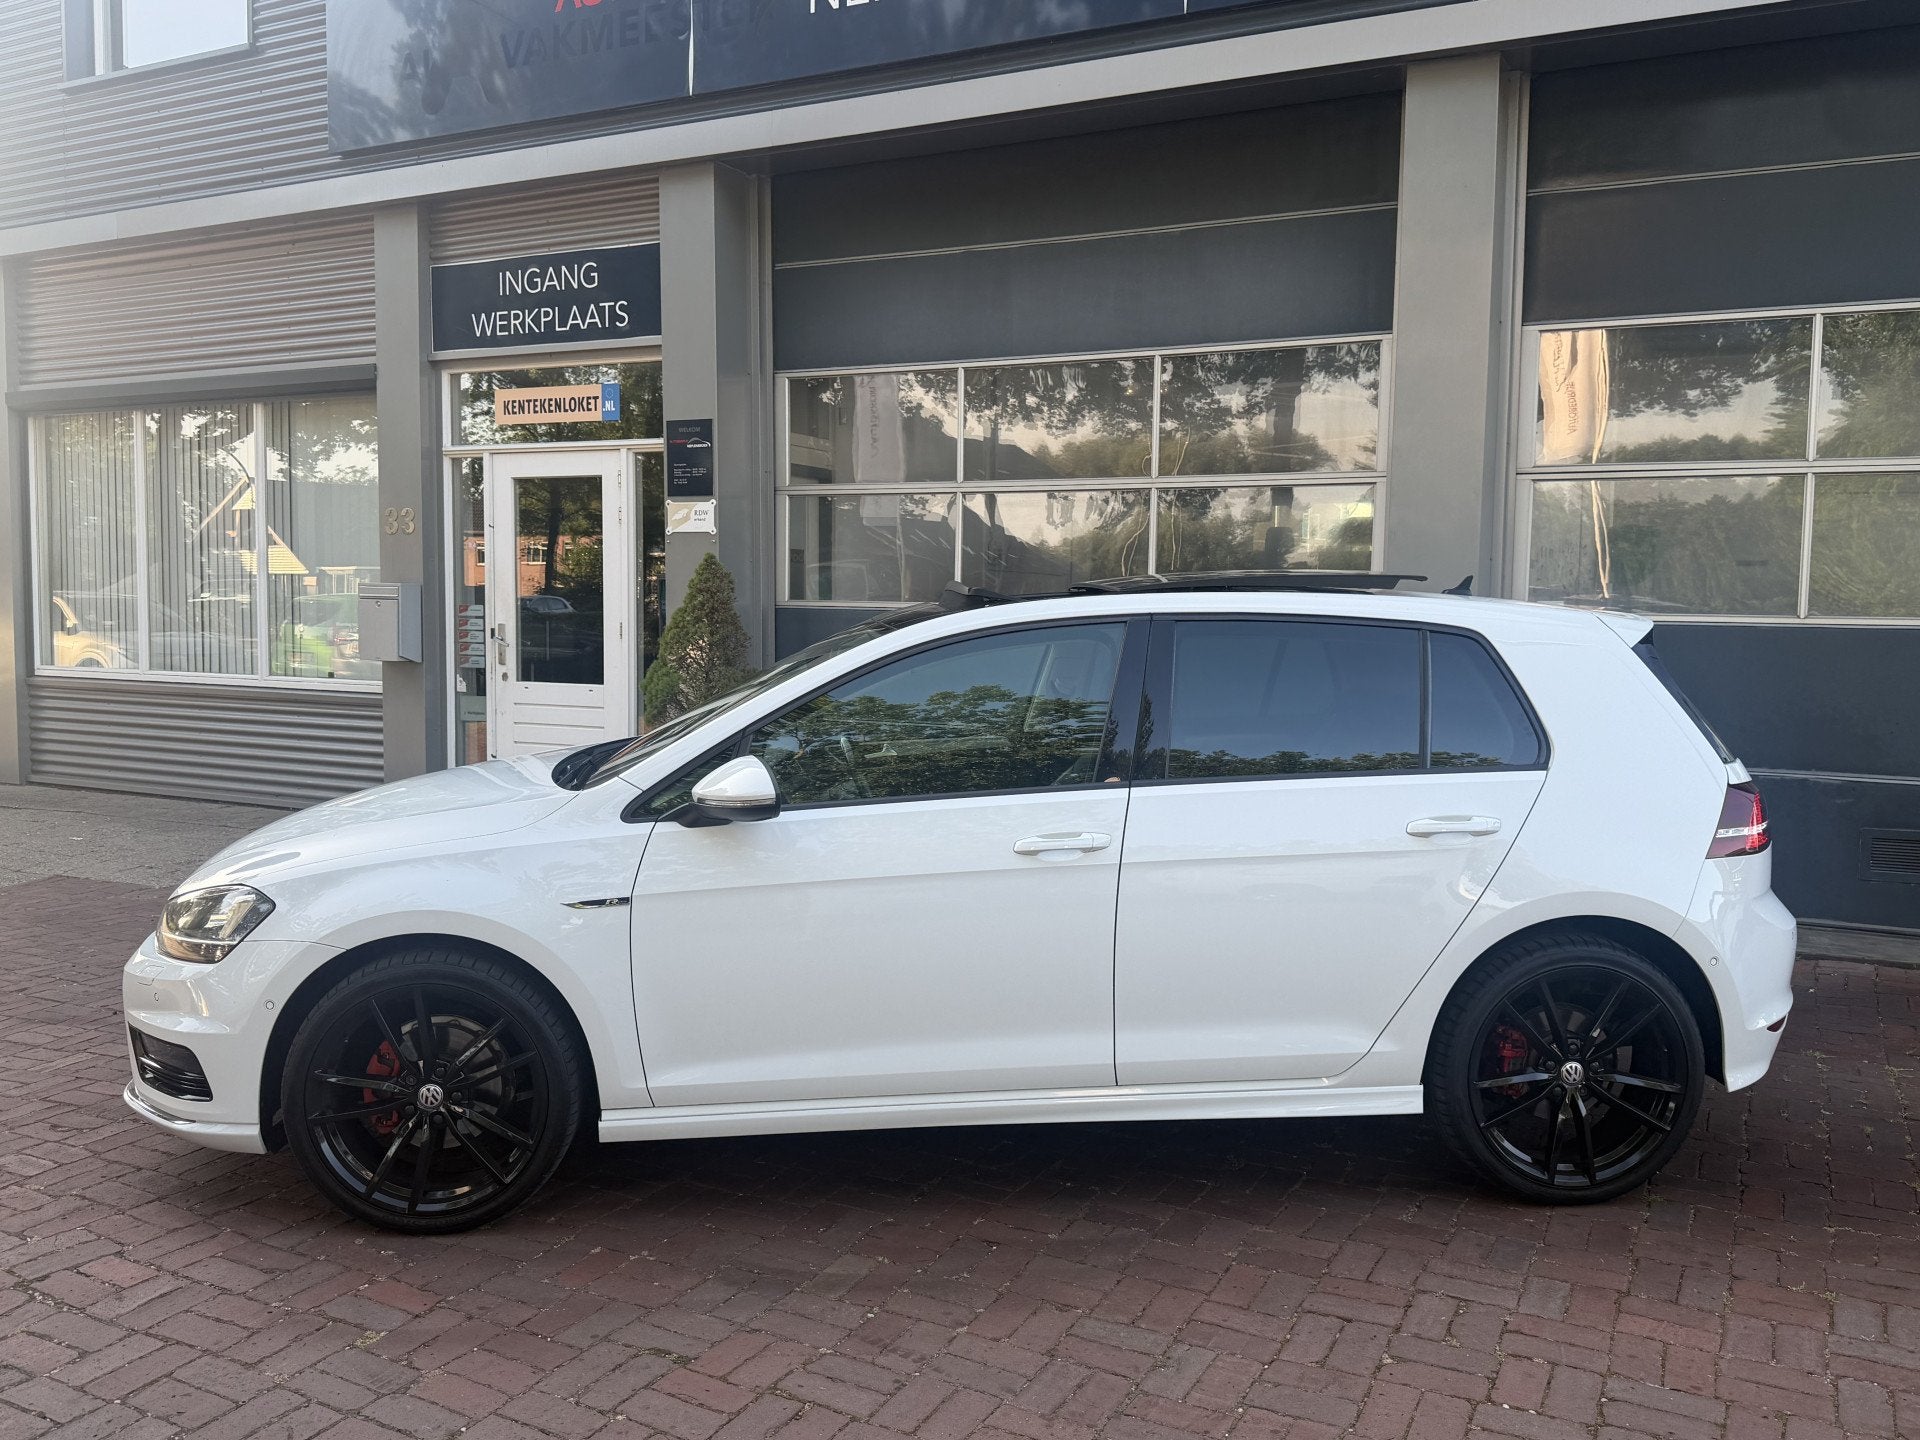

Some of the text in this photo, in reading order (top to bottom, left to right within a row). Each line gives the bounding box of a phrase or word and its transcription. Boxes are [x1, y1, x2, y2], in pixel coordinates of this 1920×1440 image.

[498, 262, 599, 296] INGANG
[471, 301, 629, 337] WERKPLAATS
[385, 508, 415, 535] 33
